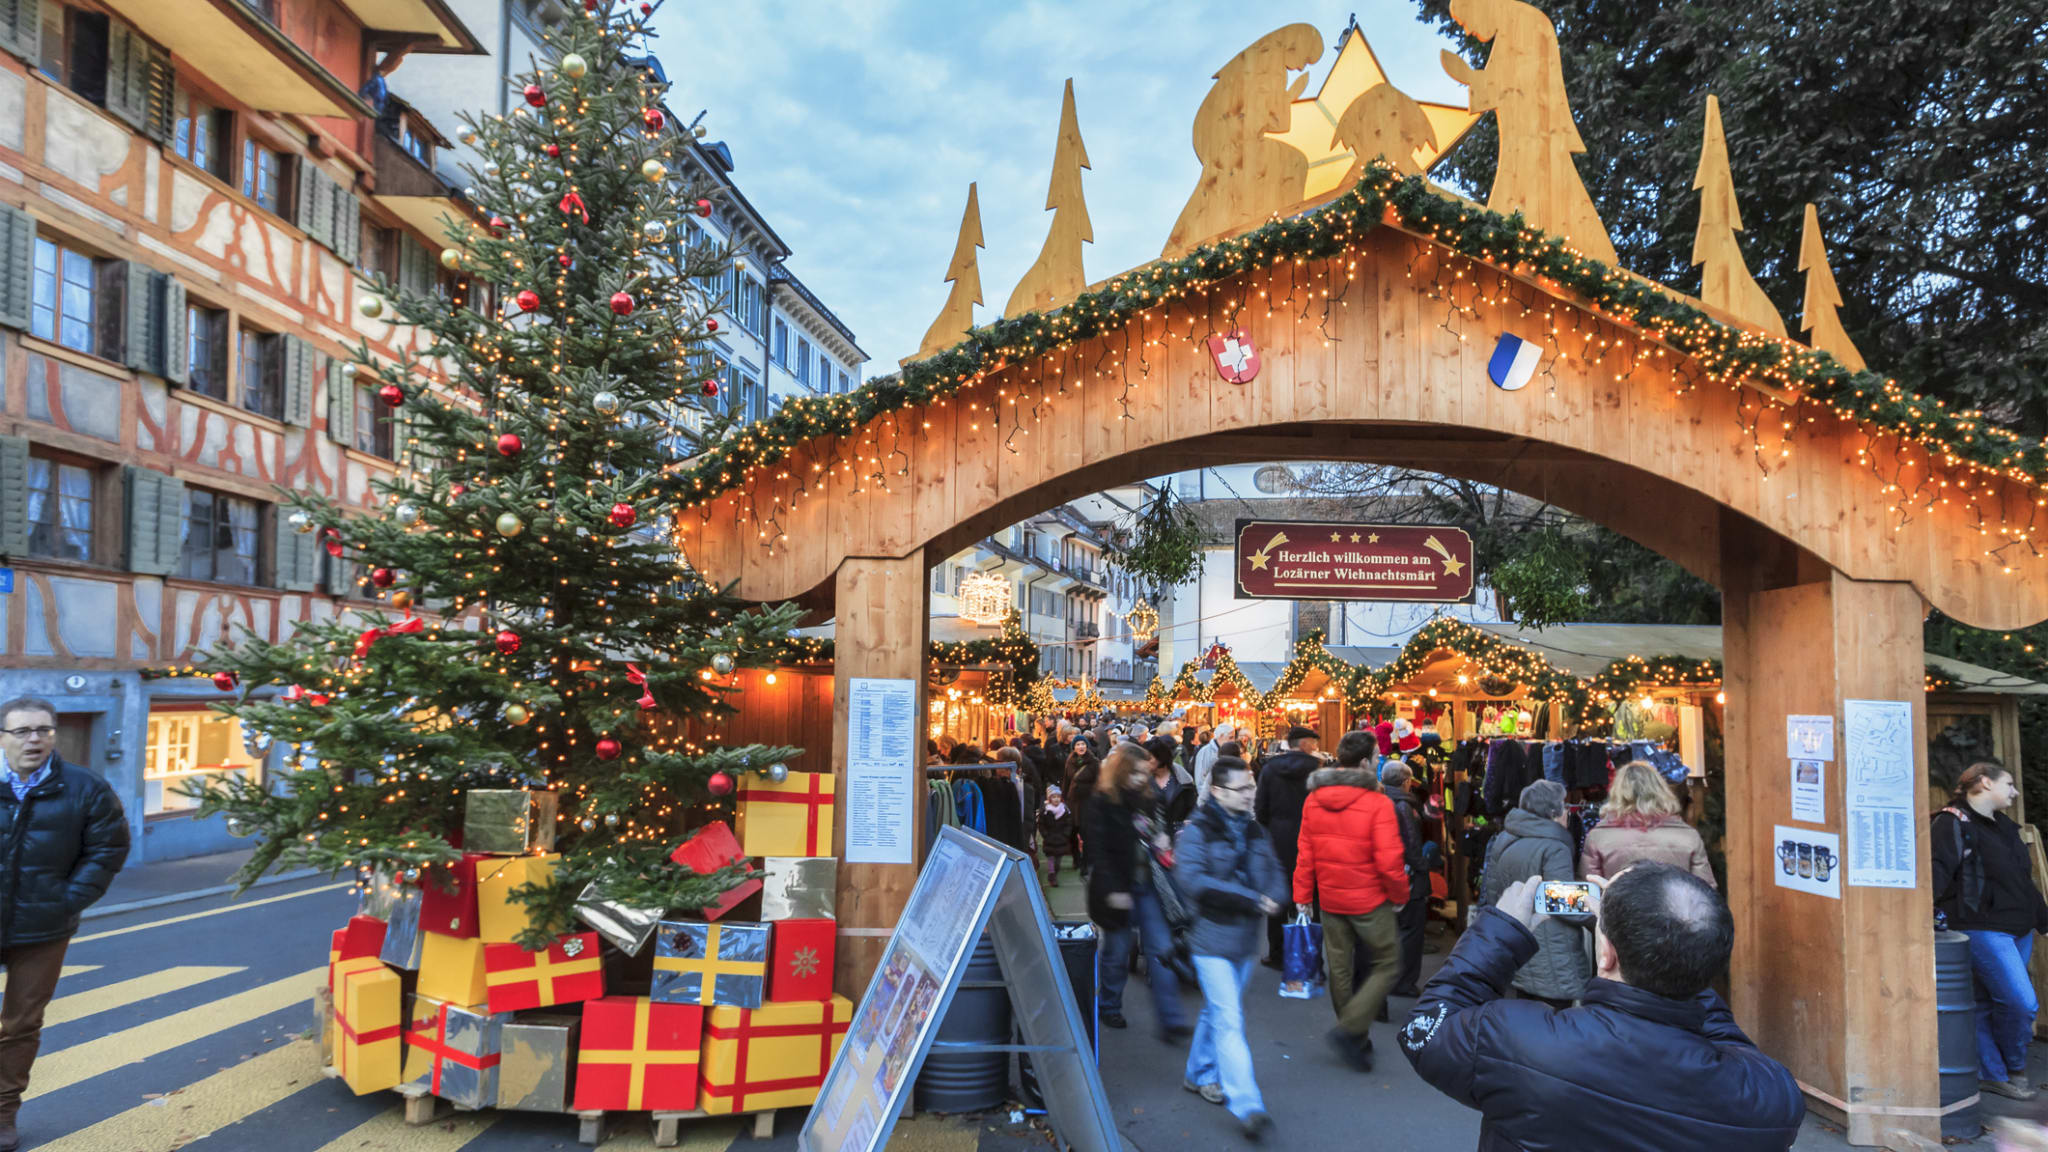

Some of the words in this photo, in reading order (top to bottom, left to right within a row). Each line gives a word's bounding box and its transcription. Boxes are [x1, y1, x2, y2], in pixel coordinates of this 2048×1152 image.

[1278, 550, 1330, 563] Herzlich
[1333, 551, 1409, 565] willkommen
[1411, 555, 1431, 565] am
[1273, 566, 1331, 580] Lozärner
[1333, 567, 1436, 582] Wiehnachtsmärt
